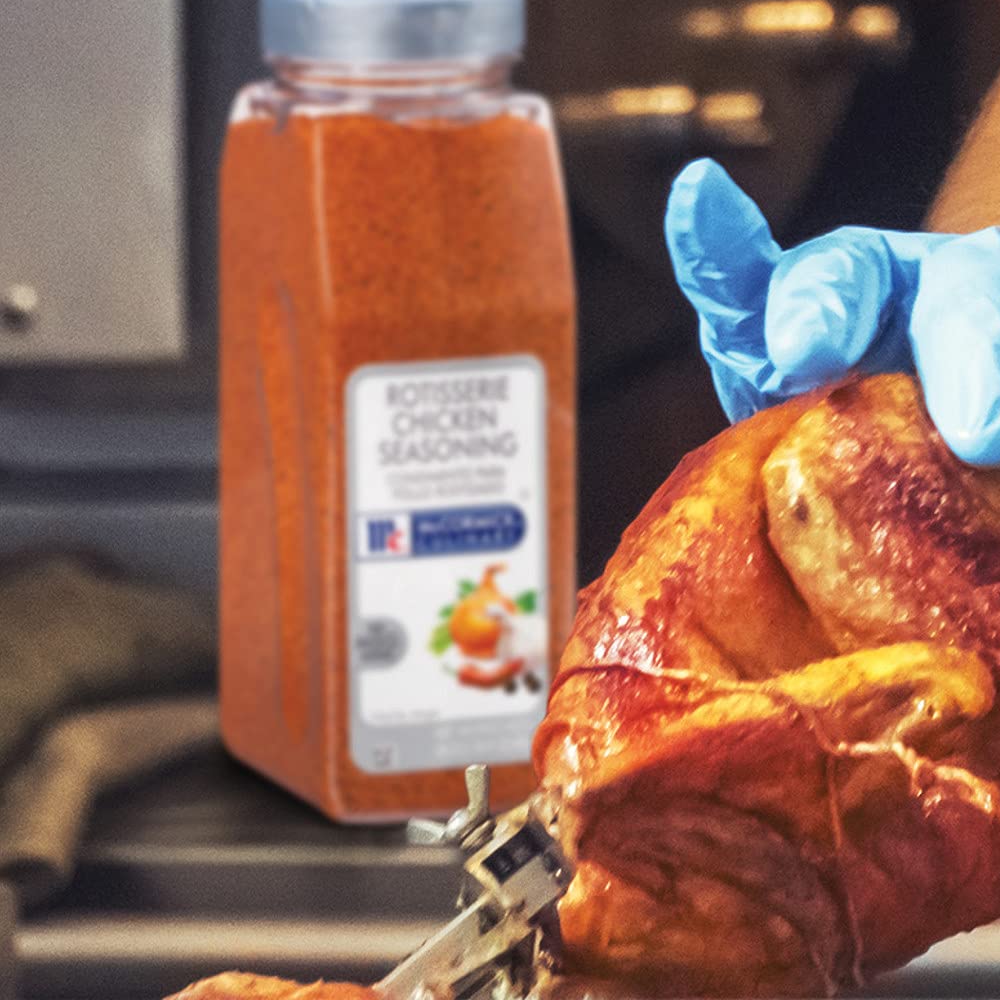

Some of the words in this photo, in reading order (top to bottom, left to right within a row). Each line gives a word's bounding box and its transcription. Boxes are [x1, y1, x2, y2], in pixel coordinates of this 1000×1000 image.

[386, 375, 509, 407] ROTISSERIE
[392, 404, 498, 435] CHICKEN
[379, 430, 519, 466] SEASONING
